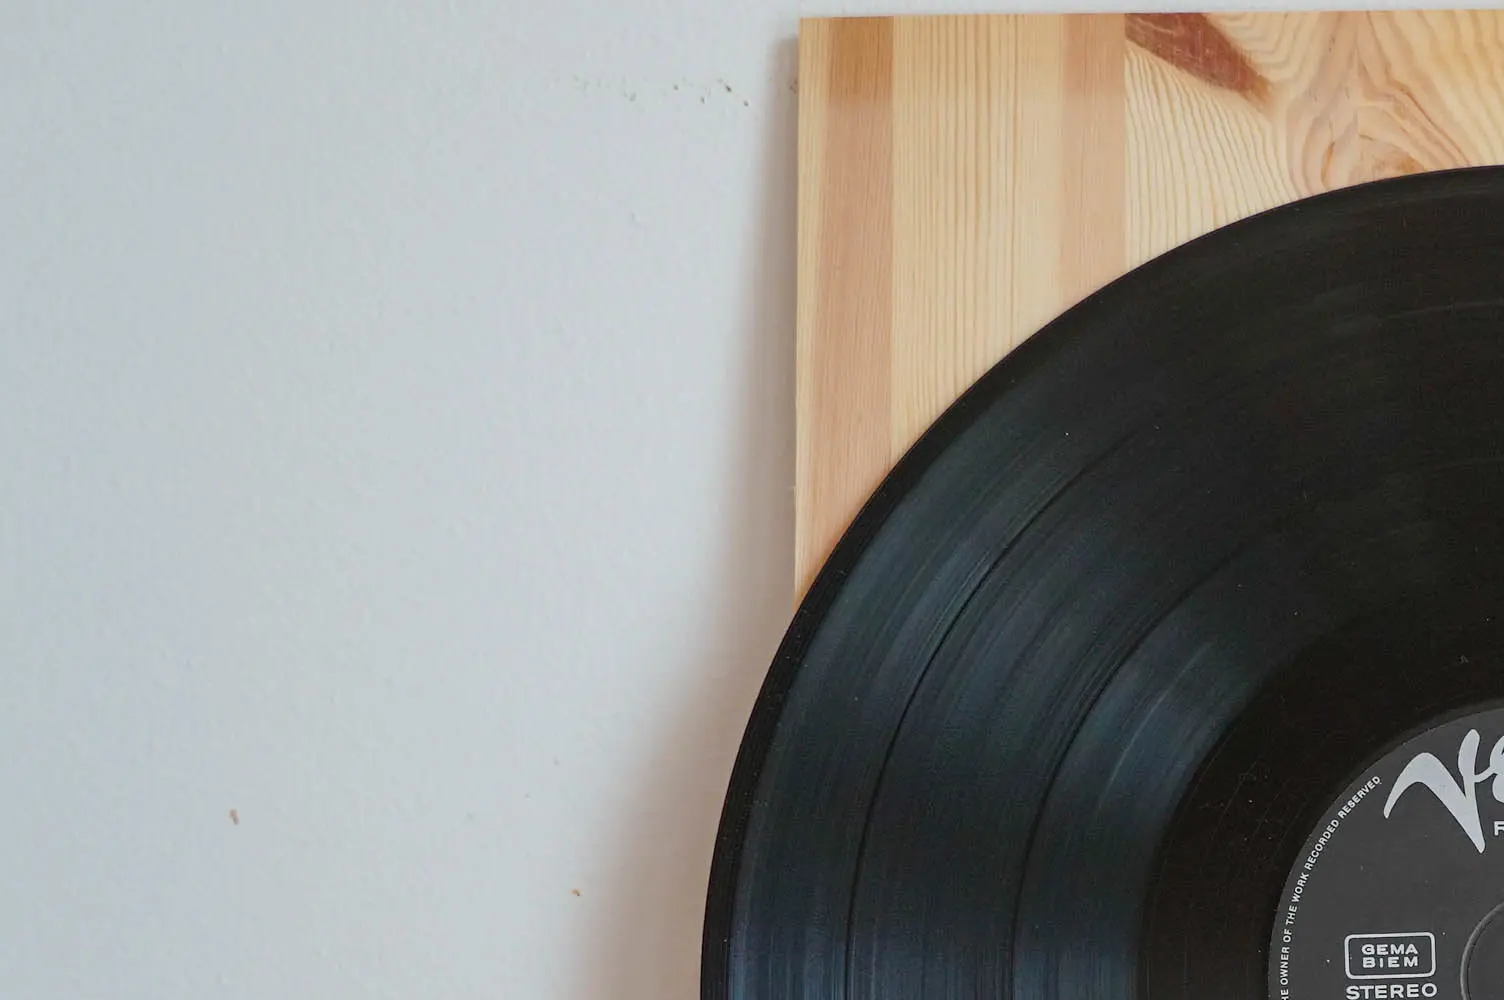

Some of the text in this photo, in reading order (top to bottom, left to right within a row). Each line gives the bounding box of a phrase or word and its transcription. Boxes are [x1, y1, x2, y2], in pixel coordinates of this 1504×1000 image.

[1337, 775, 1383, 819] RESERVED
[1303, 819, 1340, 871] RECORDED
[1291, 871, 1310, 903] WORK
[1285, 904, 1298, 926] THE
[1282, 928, 1293, 943] OF
[1361, 943, 1418, 955] GEMA
[1279, 946, 1291, 986] OWNER
[1362, 956, 1418, 968] BIEM
[1345, 982, 1437, 1000] STEREO
